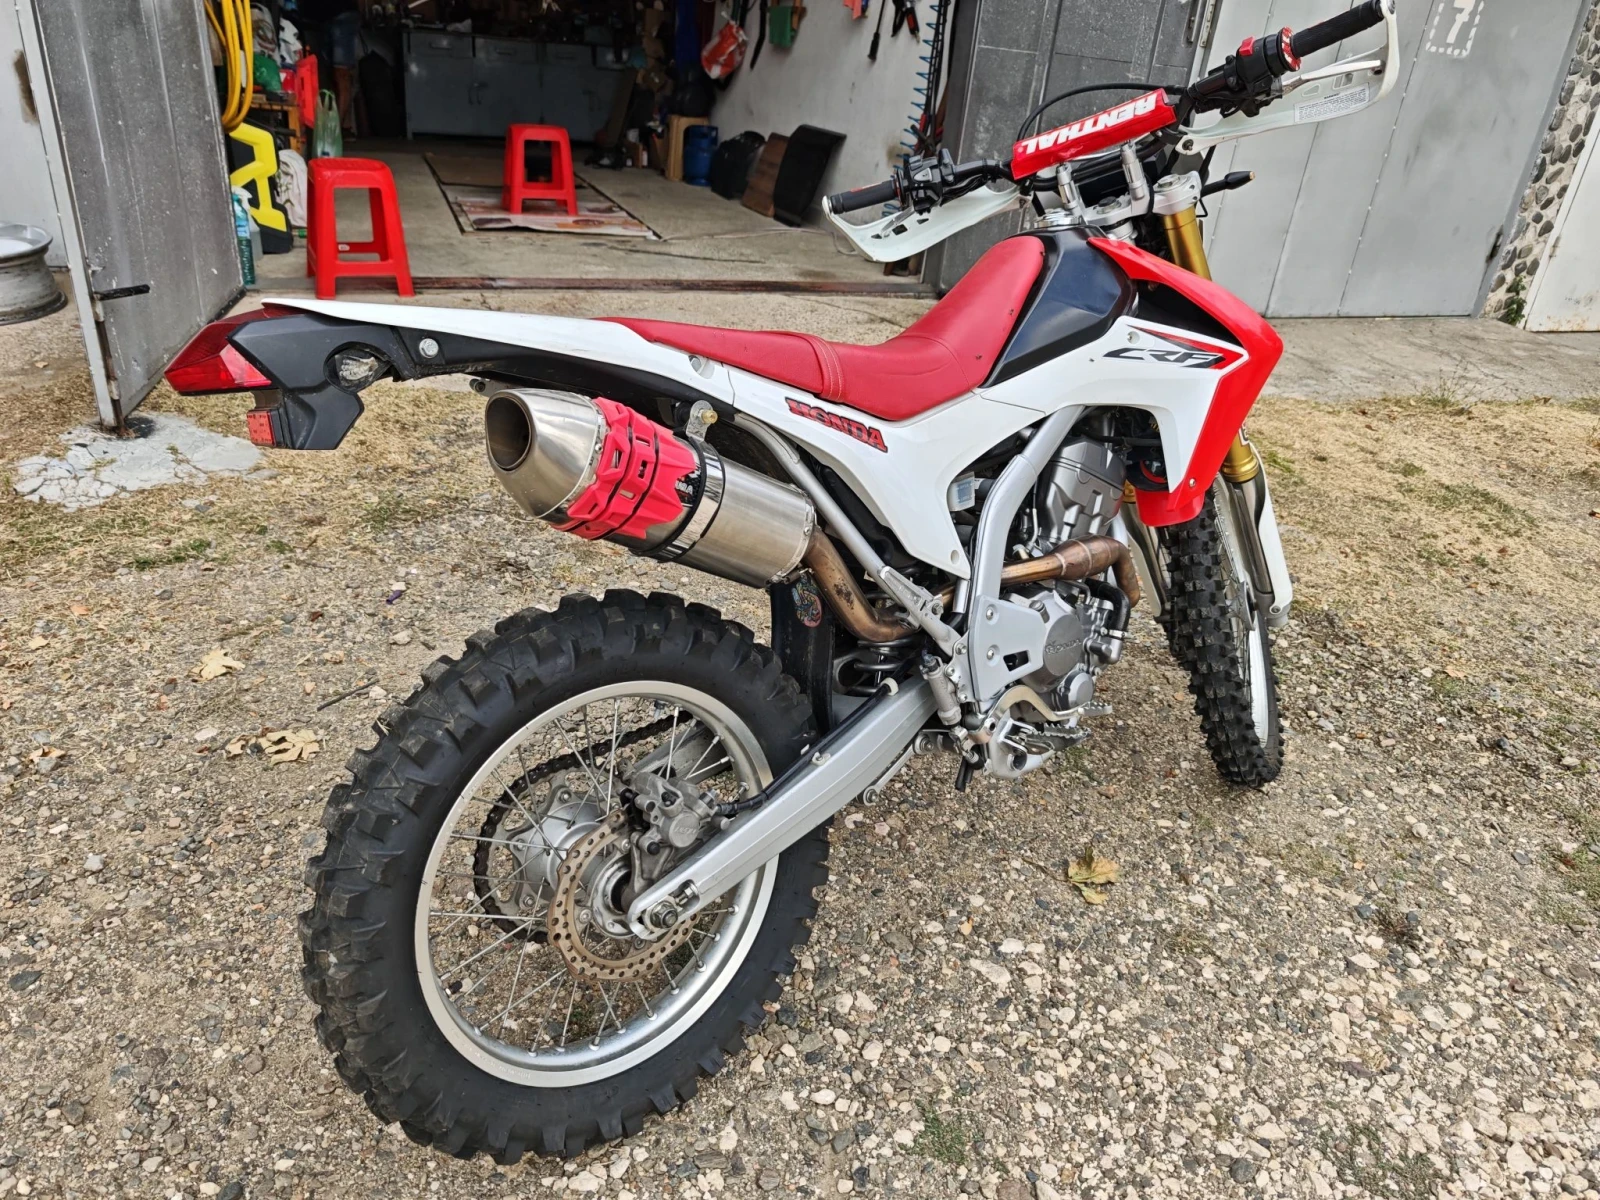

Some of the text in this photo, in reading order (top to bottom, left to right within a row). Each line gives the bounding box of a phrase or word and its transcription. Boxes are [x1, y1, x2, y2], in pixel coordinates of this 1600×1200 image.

[1021, 93, 1158, 155] RENTHAL
[1102, 347, 1226, 369] CRF
[784, 396, 888, 454] HONDA
